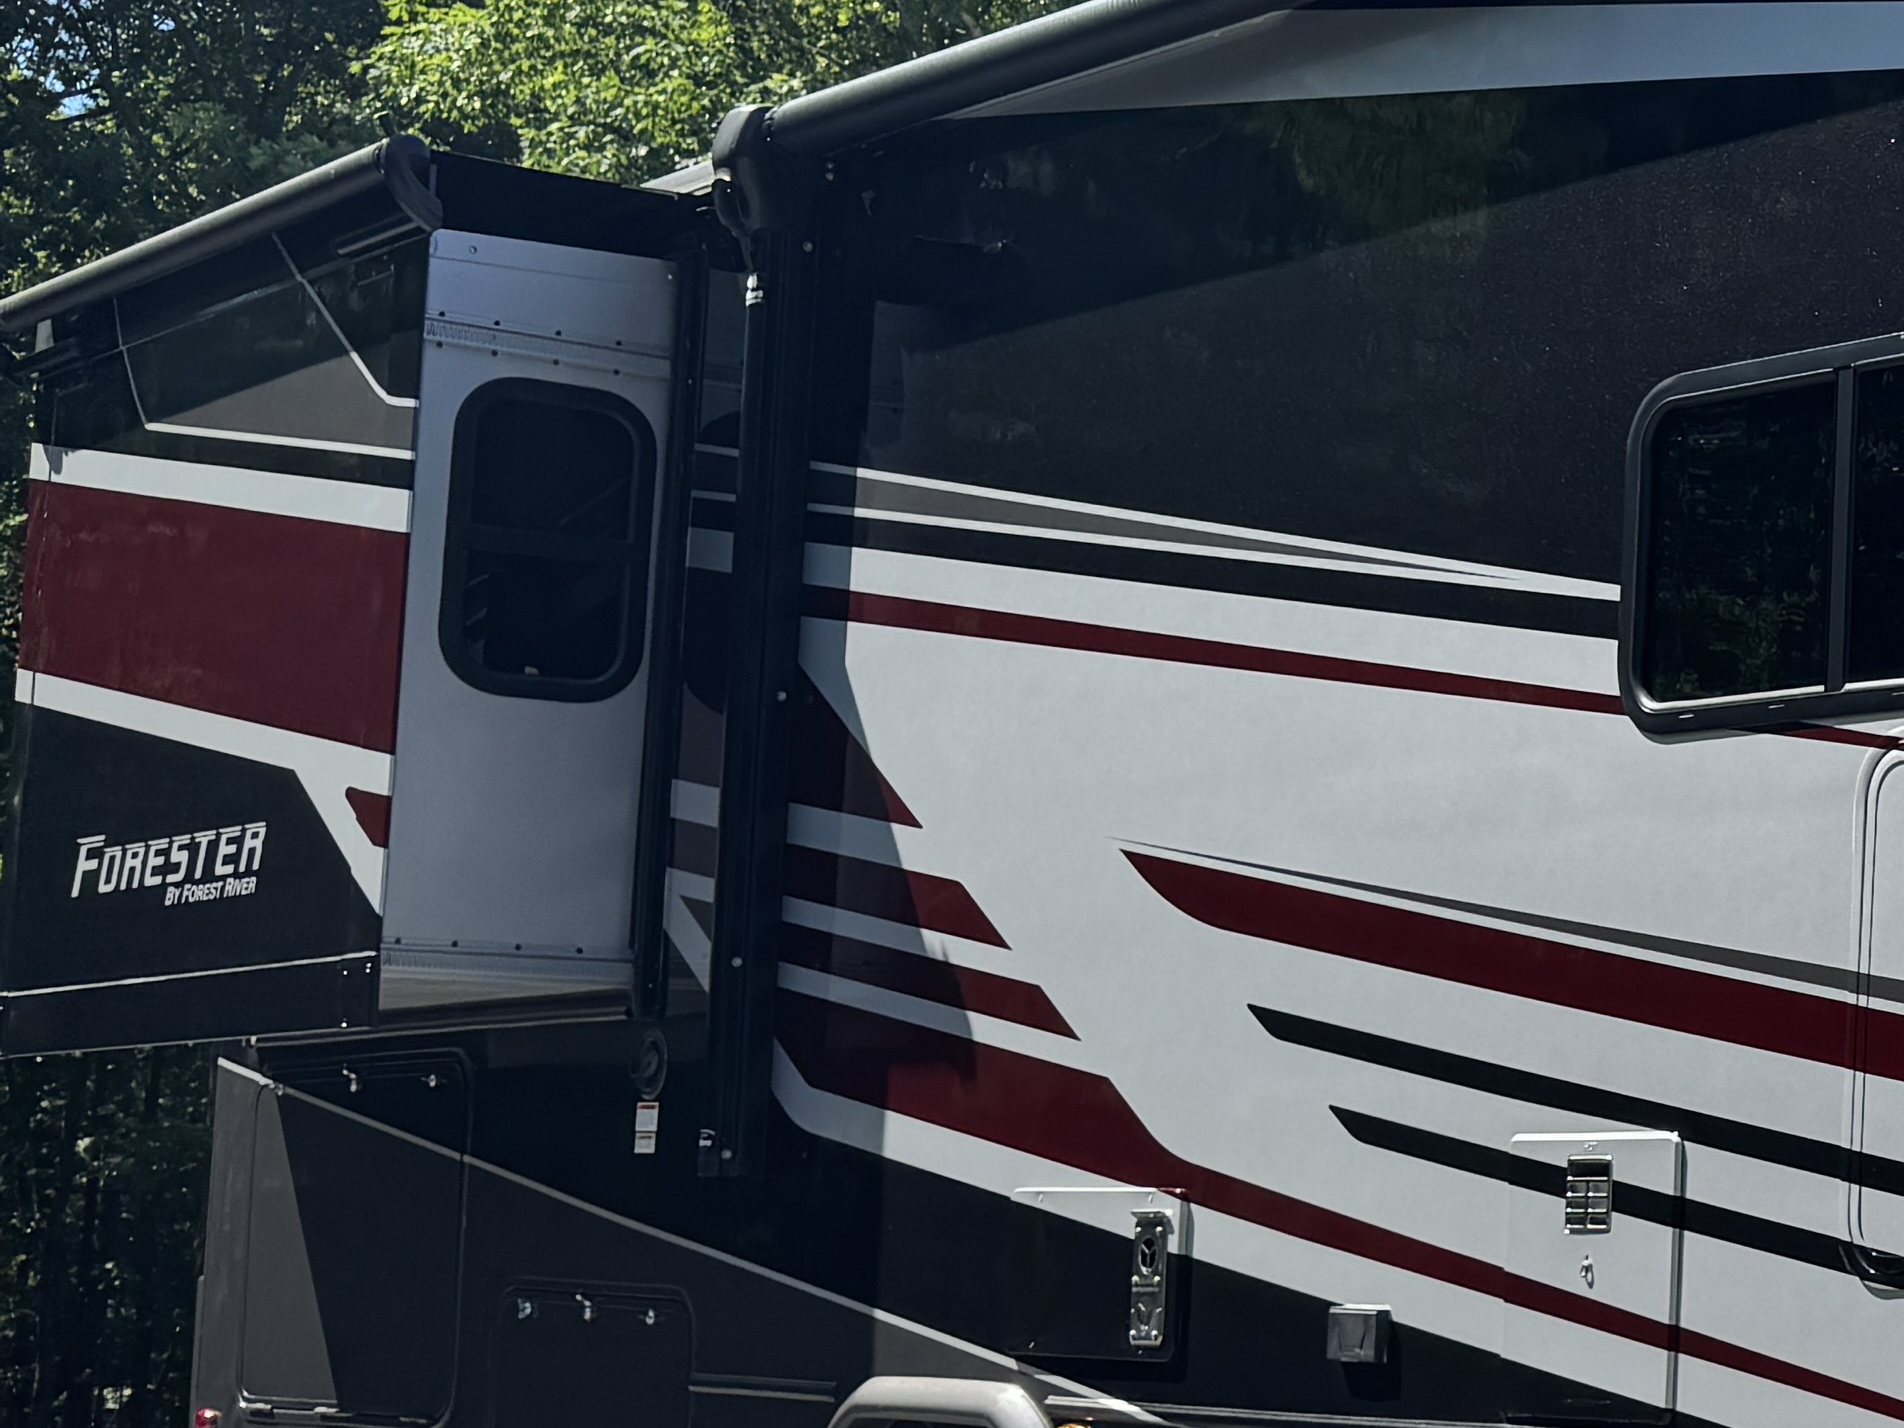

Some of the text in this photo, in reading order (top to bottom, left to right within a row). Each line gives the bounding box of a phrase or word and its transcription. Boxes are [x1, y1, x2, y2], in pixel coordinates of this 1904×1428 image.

[71, 821, 267, 898] FORESTER
[164, 876, 257, 906] BY FOREST RIVER
